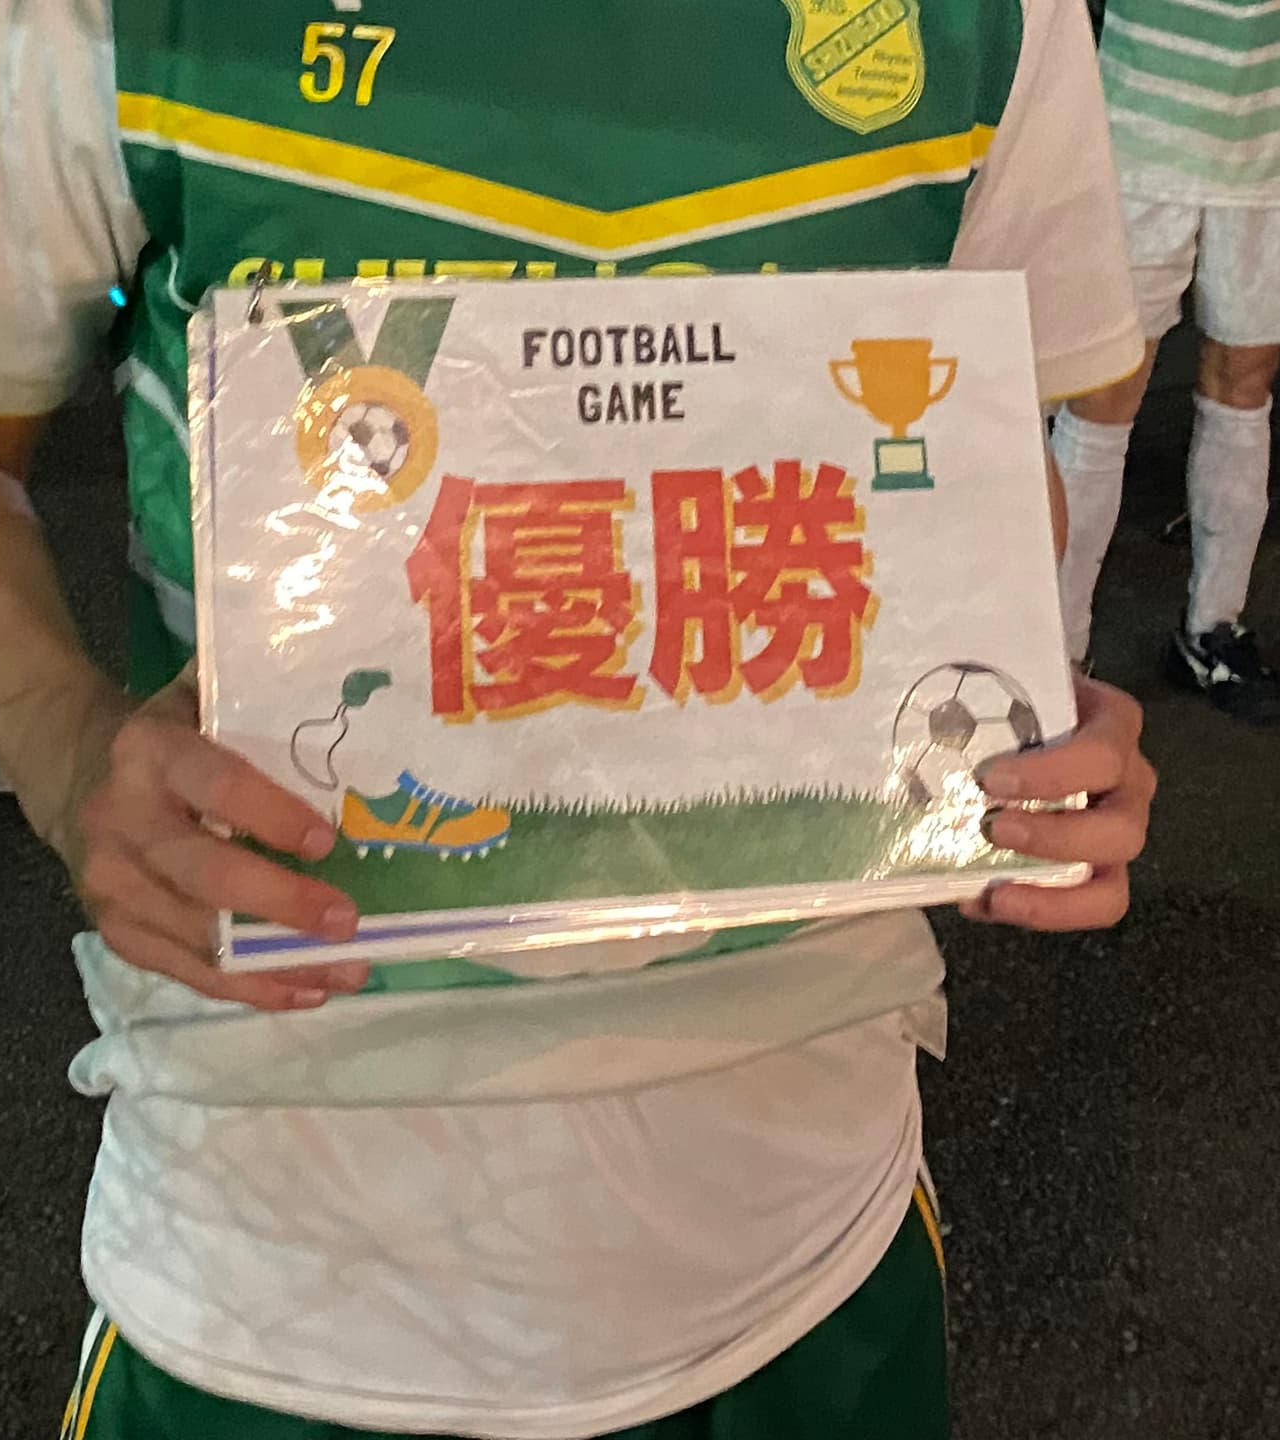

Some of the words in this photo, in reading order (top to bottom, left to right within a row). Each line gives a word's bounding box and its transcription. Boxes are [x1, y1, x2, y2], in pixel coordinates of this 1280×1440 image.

[298, 21, 396, 106] 57
[522, 323, 736, 367] FOOTBALL
[578, 380, 685, 423] GAME
[405, 459, 881, 724] 優勝
